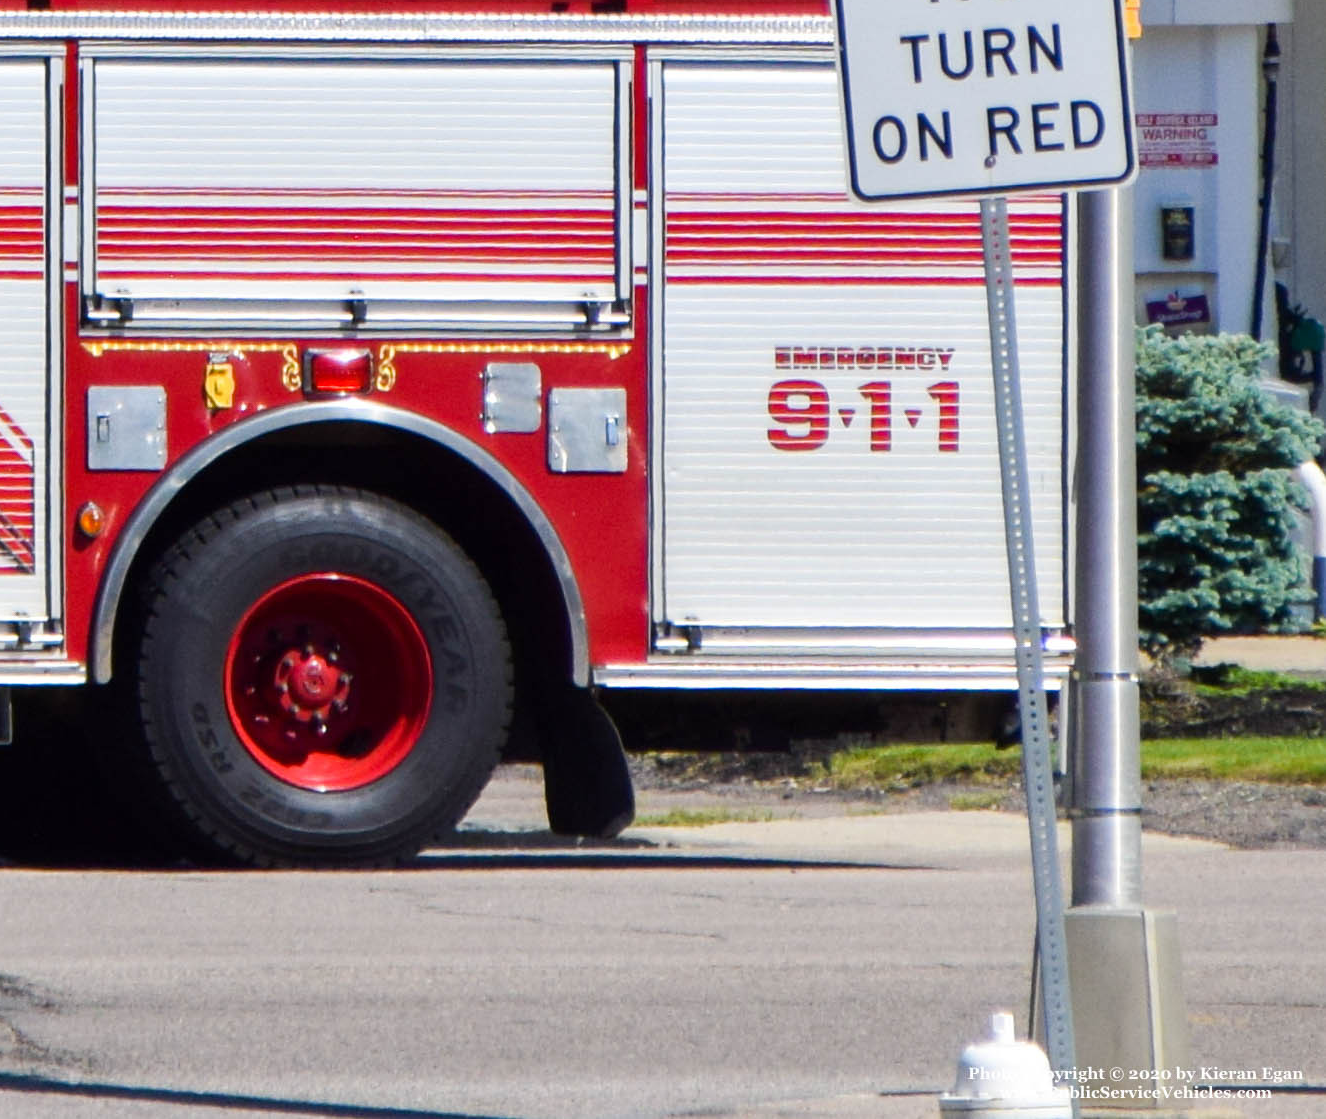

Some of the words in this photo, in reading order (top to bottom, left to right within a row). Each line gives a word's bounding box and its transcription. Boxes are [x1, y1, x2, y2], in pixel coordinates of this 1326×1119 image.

[900, 23, 1064, 83] TURN
[872, 110, 953, 164] ON
[987, 100, 1106, 157] RED
[1143, 128, 1208, 140] WARNING
[775, 346, 956, 371] EMERGENCY
